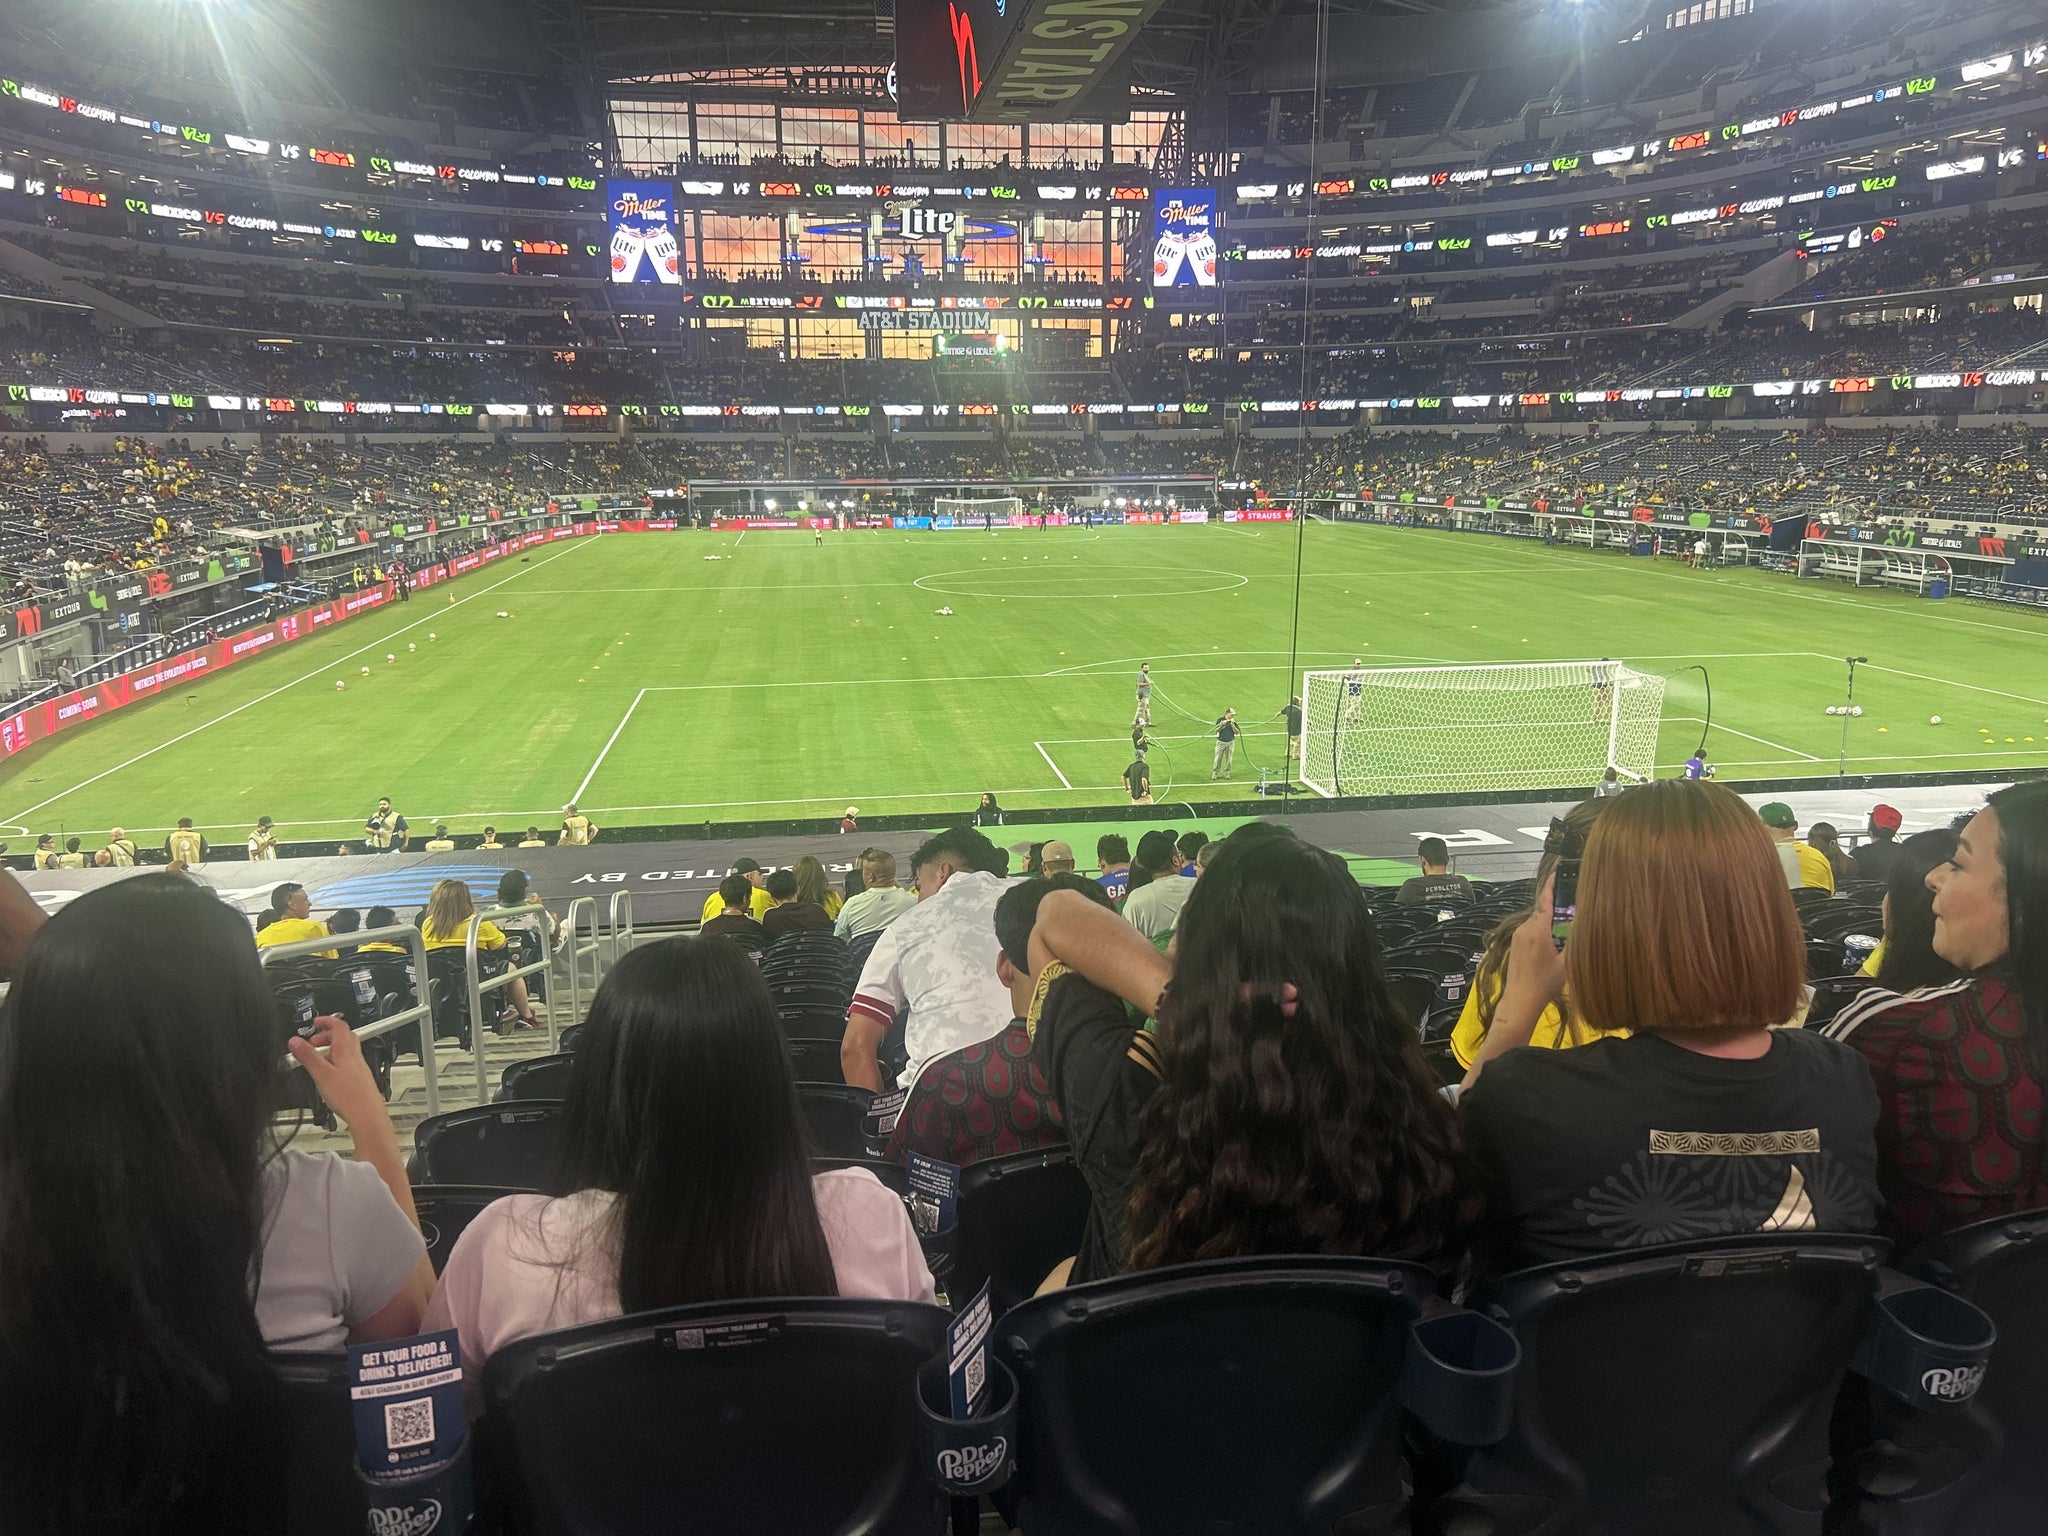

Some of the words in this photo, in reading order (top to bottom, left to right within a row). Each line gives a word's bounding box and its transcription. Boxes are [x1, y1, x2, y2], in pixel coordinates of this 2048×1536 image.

[2024, 46, 2046, 67] VS
[60, 96, 76, 113] VS
[1781, 109, 1798, 127] VS
[280, 144, 299, 158] VS
[1642, 141, 1660, 157] VS
[1998, 150, 2022, 167] VS
[438, 166, 456, 179] VS
[1432, 172, 1448, 185] VS
[25, 179, 46, 196] VS
[733, 183, 750, 195] VS
[875, 185, 890, 197] VS
[1085, 187, 1101, 198] VS
[1287, 183, 1304, 196] VS
[613, 199, 666, 218] Miller
[1160, 205, 1209, 225] Miller
[1719, 204, 1737, 218] VS
[204, 211, 225, 226] VS
[898, 207, 956, 240] Lite
[1549, 227, 1568, 240] VS
[481, 238, 502, 252] VS
[613, 237, 636, 255] Lite
[654, 240, 675, 257] Lite
[1157, 244, 1177, 259] Lite
[1195, 245, 1216, 260] Lite
[1294, 248, 1313, 258] VS
[740, 298, 792, 306] MEXTOUR
[958, 298, 979, 308] COL
[1054, 298, 1102, 307] MEXTOUR
[858, 311, 904, 329] AT&T
[908, 311, 990, 329] STADIUM
[1963, 373, 1982, 387] VS
[1985, 370, 2036, 387] COLOMBIA
[1802, 381, 1821, 394] VS
[69, 389, 83, 403] VS
[1499, 395, 1513, 406] VS
[1606, 390, 1621, 401] VS
[247, 398, 260, 410] VS
[344, 402, 355, 413] VS
[537, 404, 553, 415] VS
[723, 405, 739, 415] VS
[933, 405, 949, 415] VS
[1070, 404, 1086, 414] VS
[1302, 401, 1317, 411] VS
[1247, 512, 1282, 520] STRAUSS
[1734, 519, 1748, 527] AT&T
[1857, 530, 1874, 540] AT&T
[128, 612, 141, 628] AT&T
[134, 675, 156, 691] WITNESS
[156, 670, 165, 684] THE
[59, 703, 82, 720] COMING
[571, 872, 627, 884] BY
[1425, 883, 1461, 893] PENDLETON
[362, 1352, 381, 1366] GET
[382, 1347, 410, 1363] YOUR
[411, 1341, 438, 1359] FOOD
[440, 1340, 447, 1353] &
[359, 1365, 396, 1382] DRINKS
[398, 1352, 453, 1377] DELIVERED!
[961, 1443, 989, 1461] Dr
[938, 1443, 1003, 1481] Pepper
[385, 1506, 415, 1525] Dr
